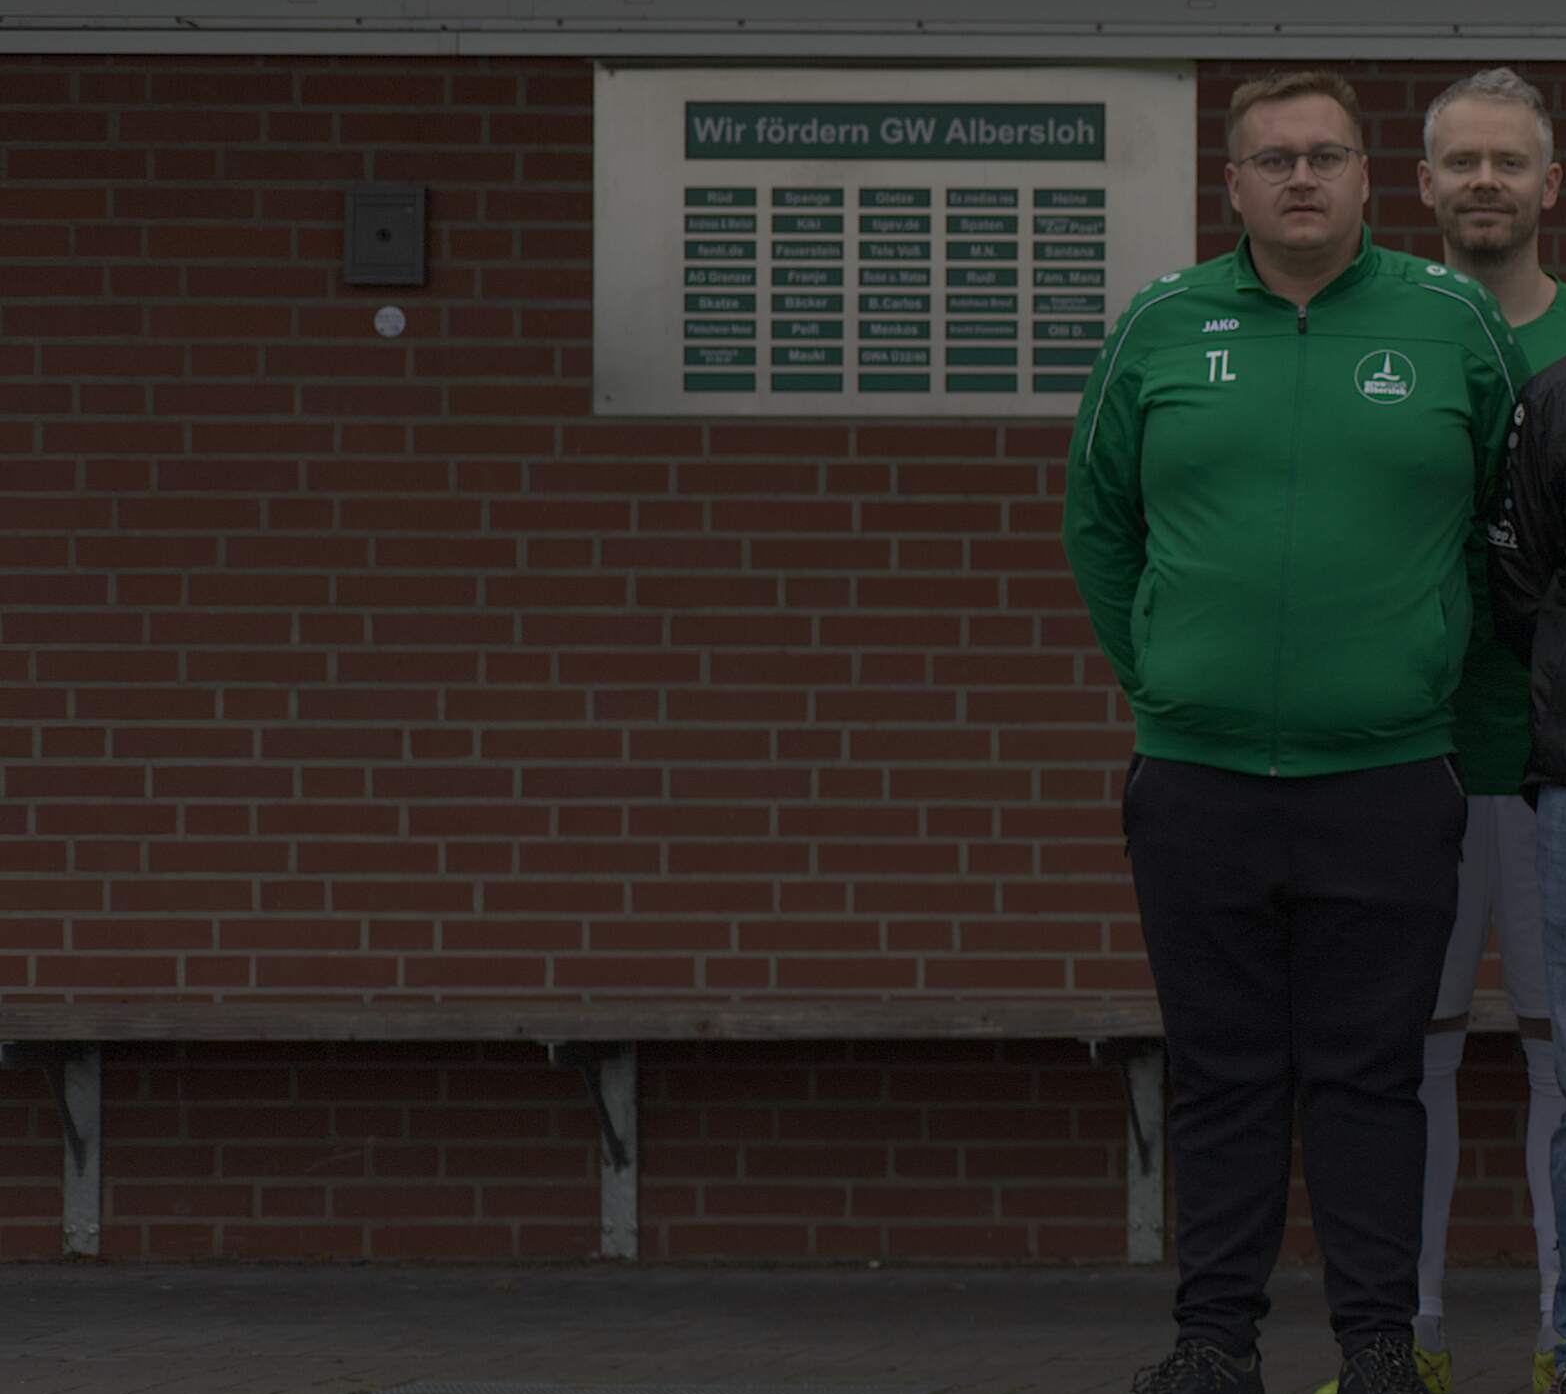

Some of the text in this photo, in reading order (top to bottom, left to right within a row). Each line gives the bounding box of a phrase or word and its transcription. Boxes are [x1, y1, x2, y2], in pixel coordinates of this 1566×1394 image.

[693, 115, 1095, 145] Wir fördern GW Albersloh
[1202, 318, 1240, 332] JAKO
[1206, 350, 1237, 382] TL
